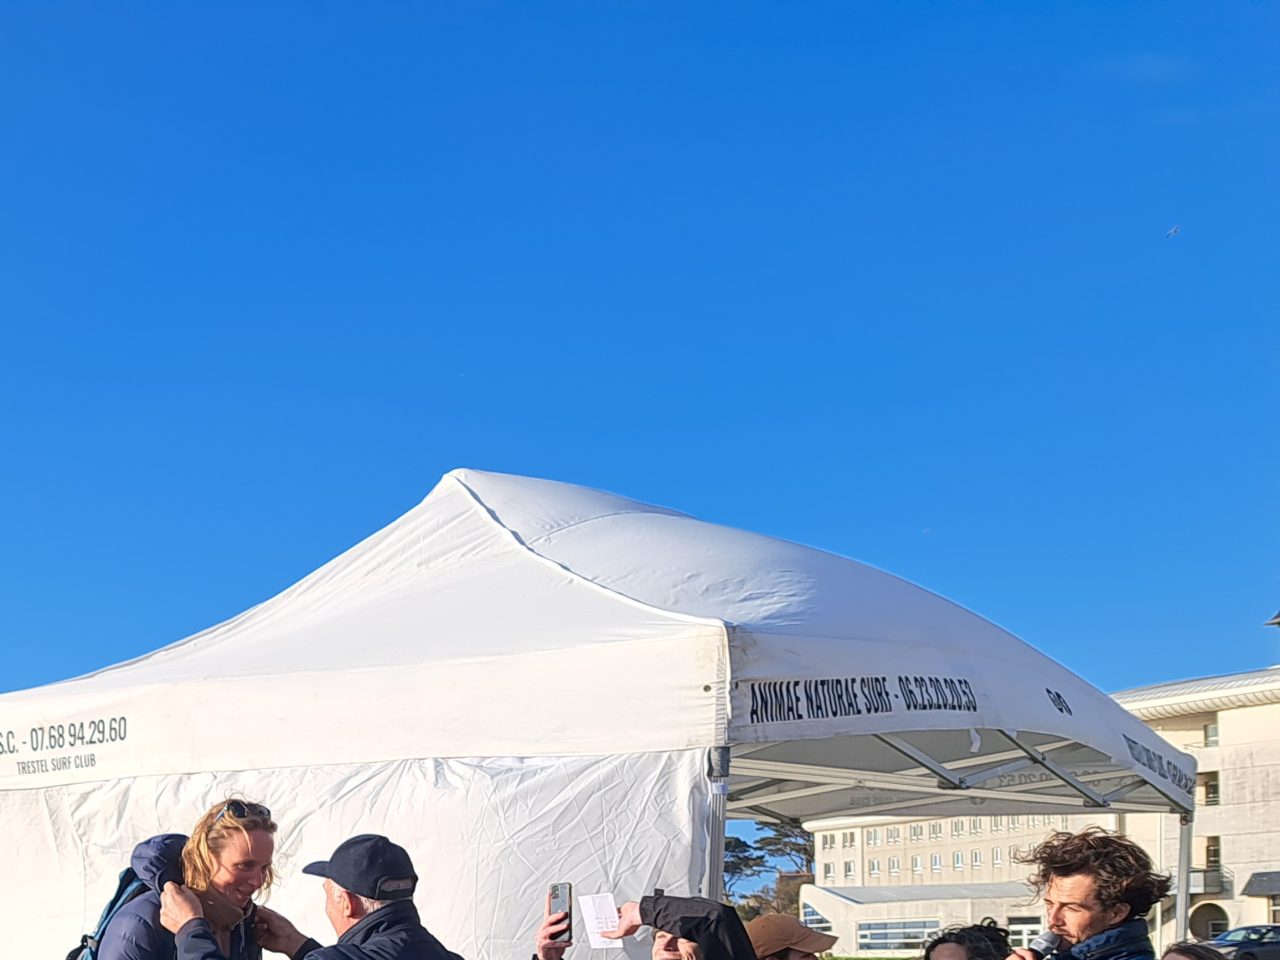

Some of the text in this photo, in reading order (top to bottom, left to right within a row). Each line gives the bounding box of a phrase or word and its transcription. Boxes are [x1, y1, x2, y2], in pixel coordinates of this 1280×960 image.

[749, 680, 803, 724] ANIMAE
[803, 677, 862, 719] NATURAE
[860, 676, 892, 714] SURF
[16, 753, 97, 775] TRESTEL SURF CLUB
